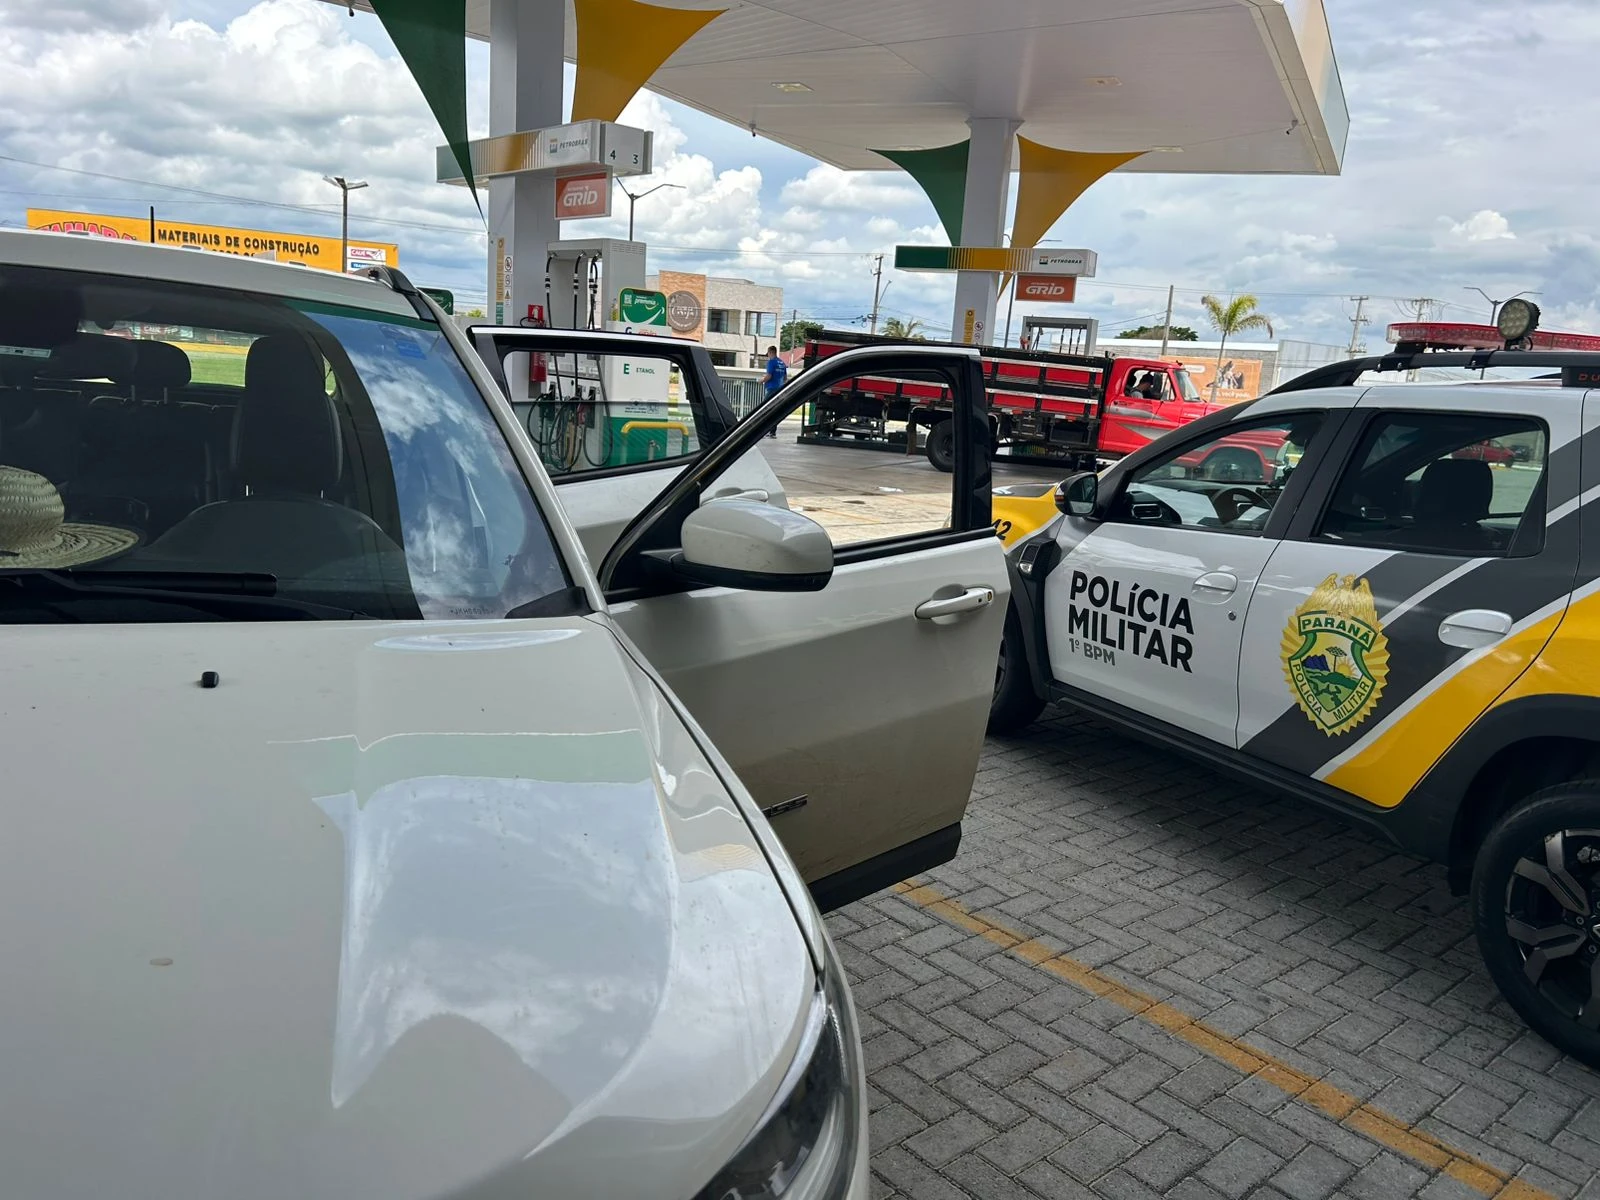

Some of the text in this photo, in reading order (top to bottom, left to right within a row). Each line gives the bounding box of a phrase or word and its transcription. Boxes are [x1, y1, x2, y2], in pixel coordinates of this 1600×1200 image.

[559, 138, 589, 149] PETROBRAS
[610, 150, 639, 164] 4 3
[158, 229, 221, 245] MATERIAIS
[226, 236, 240, 248] DE
[244, 238, 320, 257] CONSTRUÇÃO
[623, 363, 630, 375] E
[1069, 570, 1194, 635] POLÍCIA
[1068, 603, 1193, 673] MILITAR
[1302, 617, 1372, 645] PARANÁ
[1083, 642, 1116, 666] BPM
[1333, 681, 1370, 720] MILITAR
